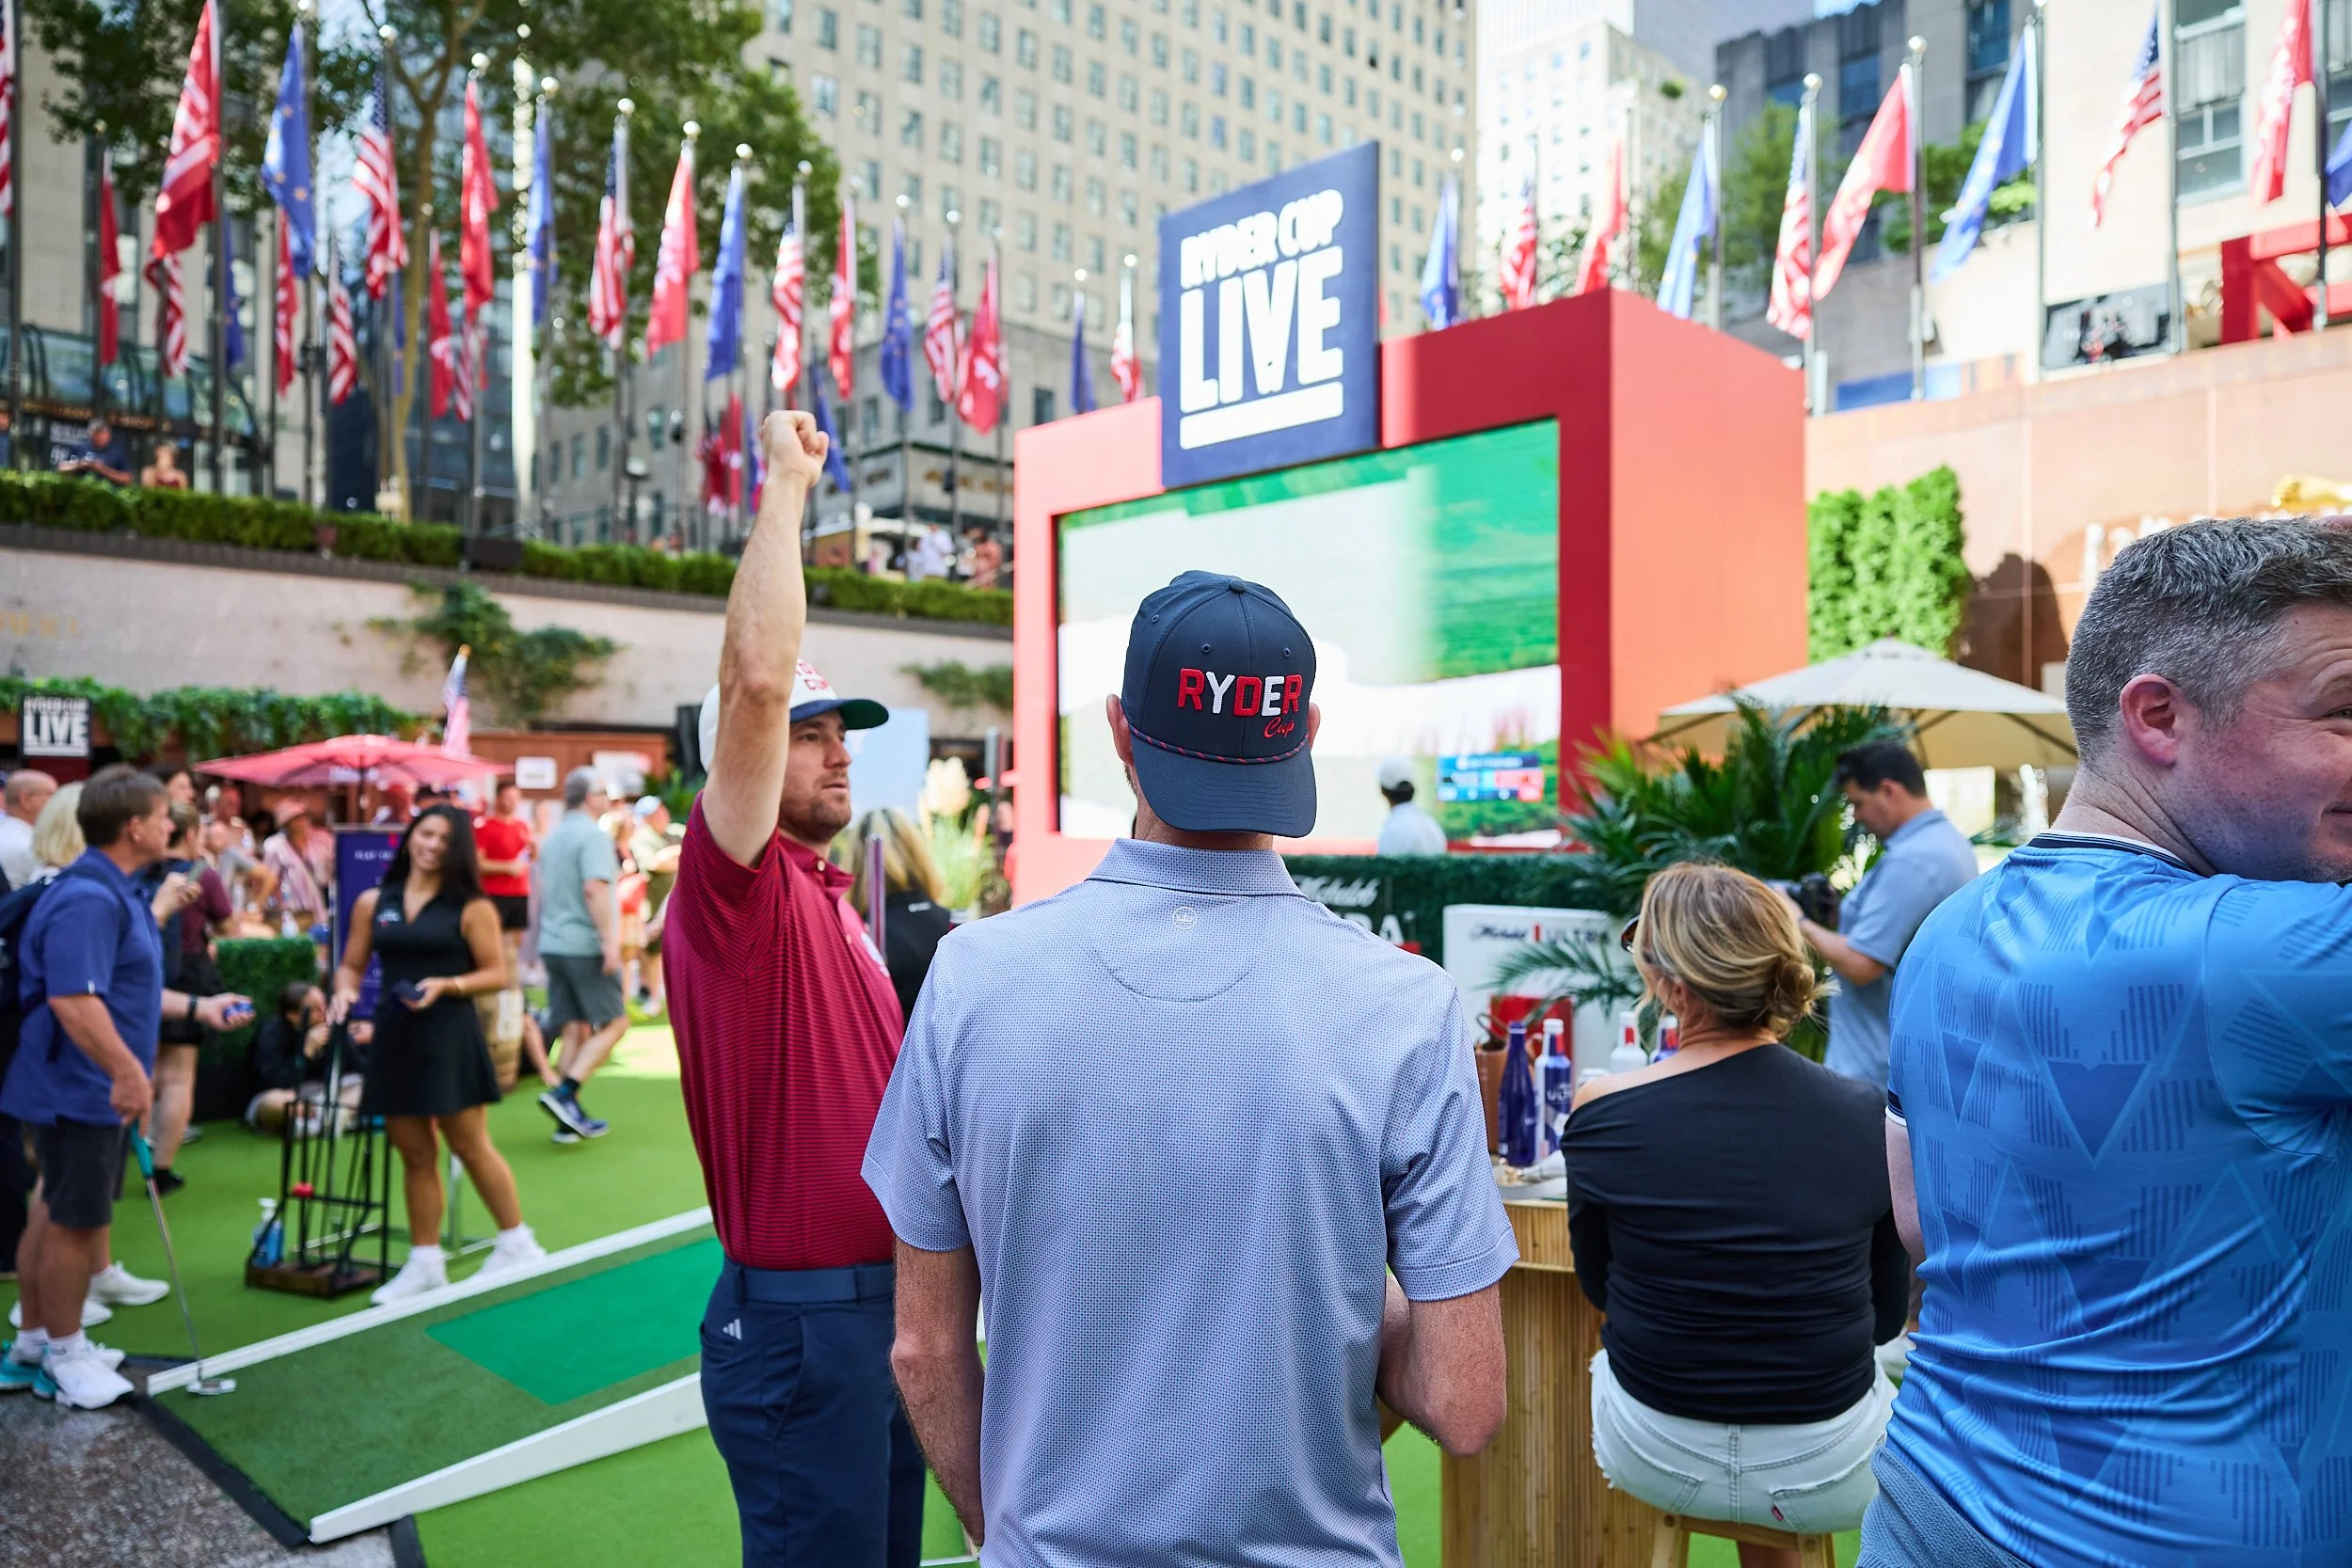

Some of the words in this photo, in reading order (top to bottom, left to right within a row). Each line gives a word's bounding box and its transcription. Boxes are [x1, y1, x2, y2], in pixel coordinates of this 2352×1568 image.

[1180, 211, 1279, 290] RYDER
[1278, 188, 1344, 258] CUP
[1180, 245, 1344, 414] LIVE
[1177, 668, 1303, 717] RYDER
[24, 711, 89, 745] LIVE
[1263, 716, 1295, 738] Cup
